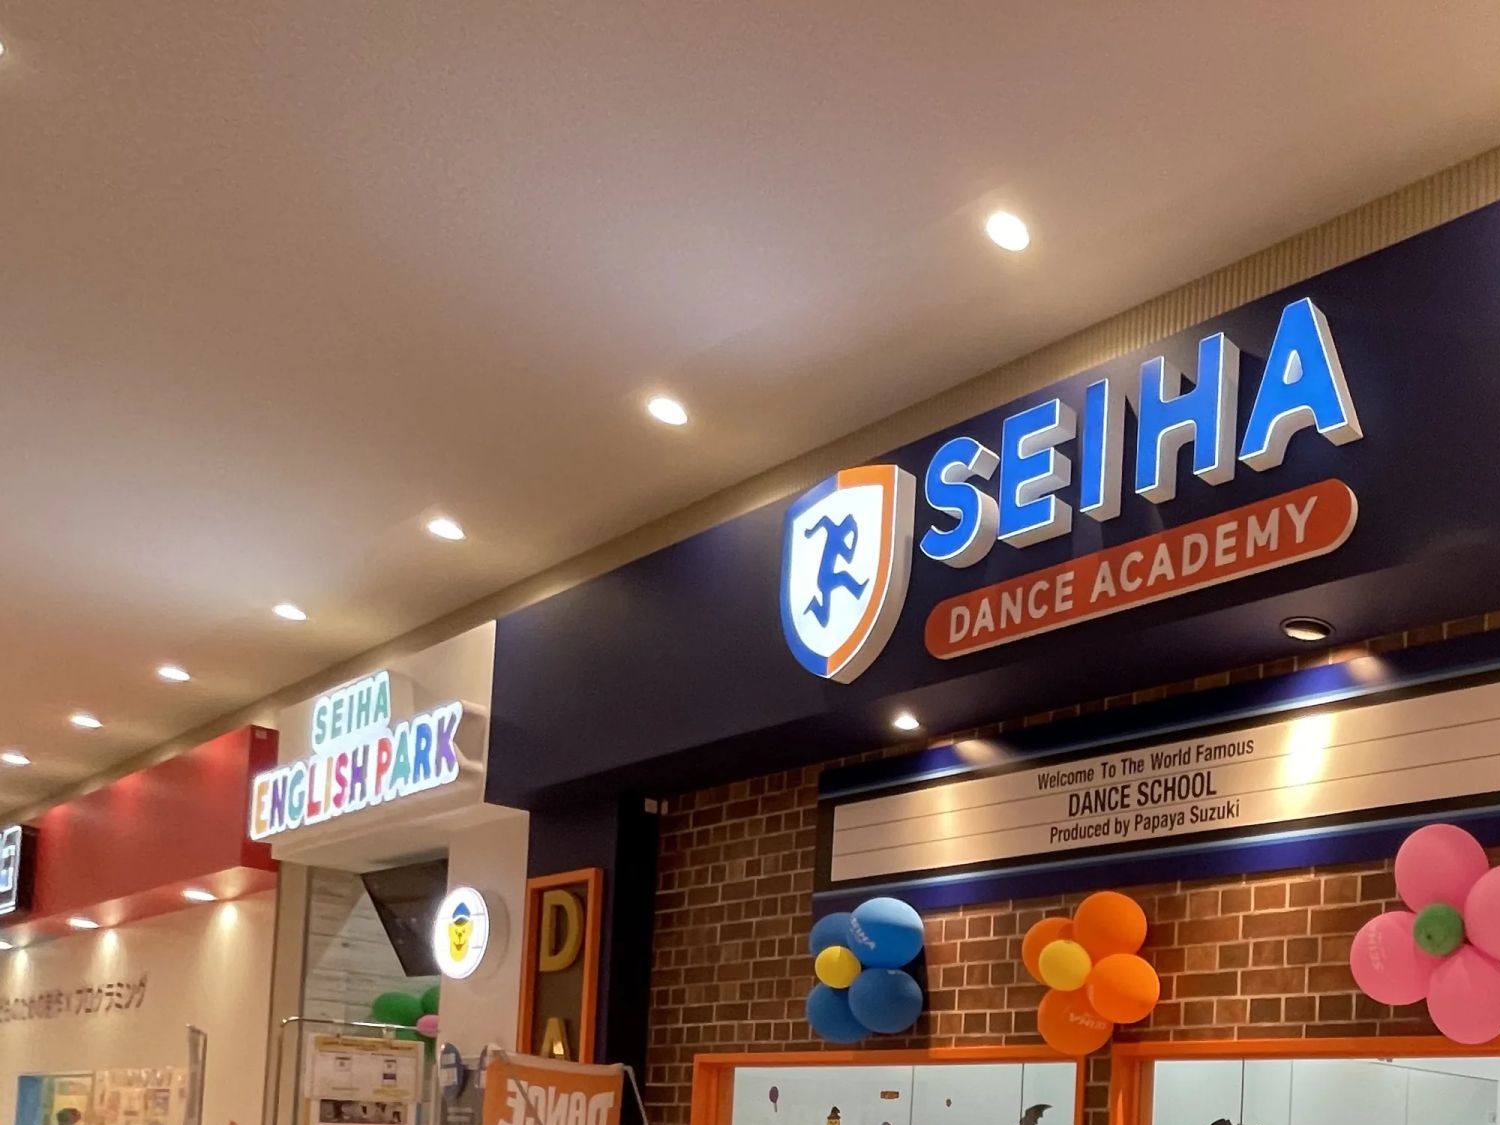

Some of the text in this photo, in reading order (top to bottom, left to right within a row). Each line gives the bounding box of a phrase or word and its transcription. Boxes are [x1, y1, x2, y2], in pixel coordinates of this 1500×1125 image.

[920, 297, 1356, 563] SEIHA
[949, 495, 1318, 645] DANCE ACADEMY
[314, 672, 390, 746] SEIHA
[253, 711, 460, 835] ENGLISH PARK
[1037, 738, 1255, 791] Welcome To The World Famous
[1068, 770, 1217, 817] DANCE SCHOOL
[1050, 799, 1240, 844] Produced by Papaya Suzuki
